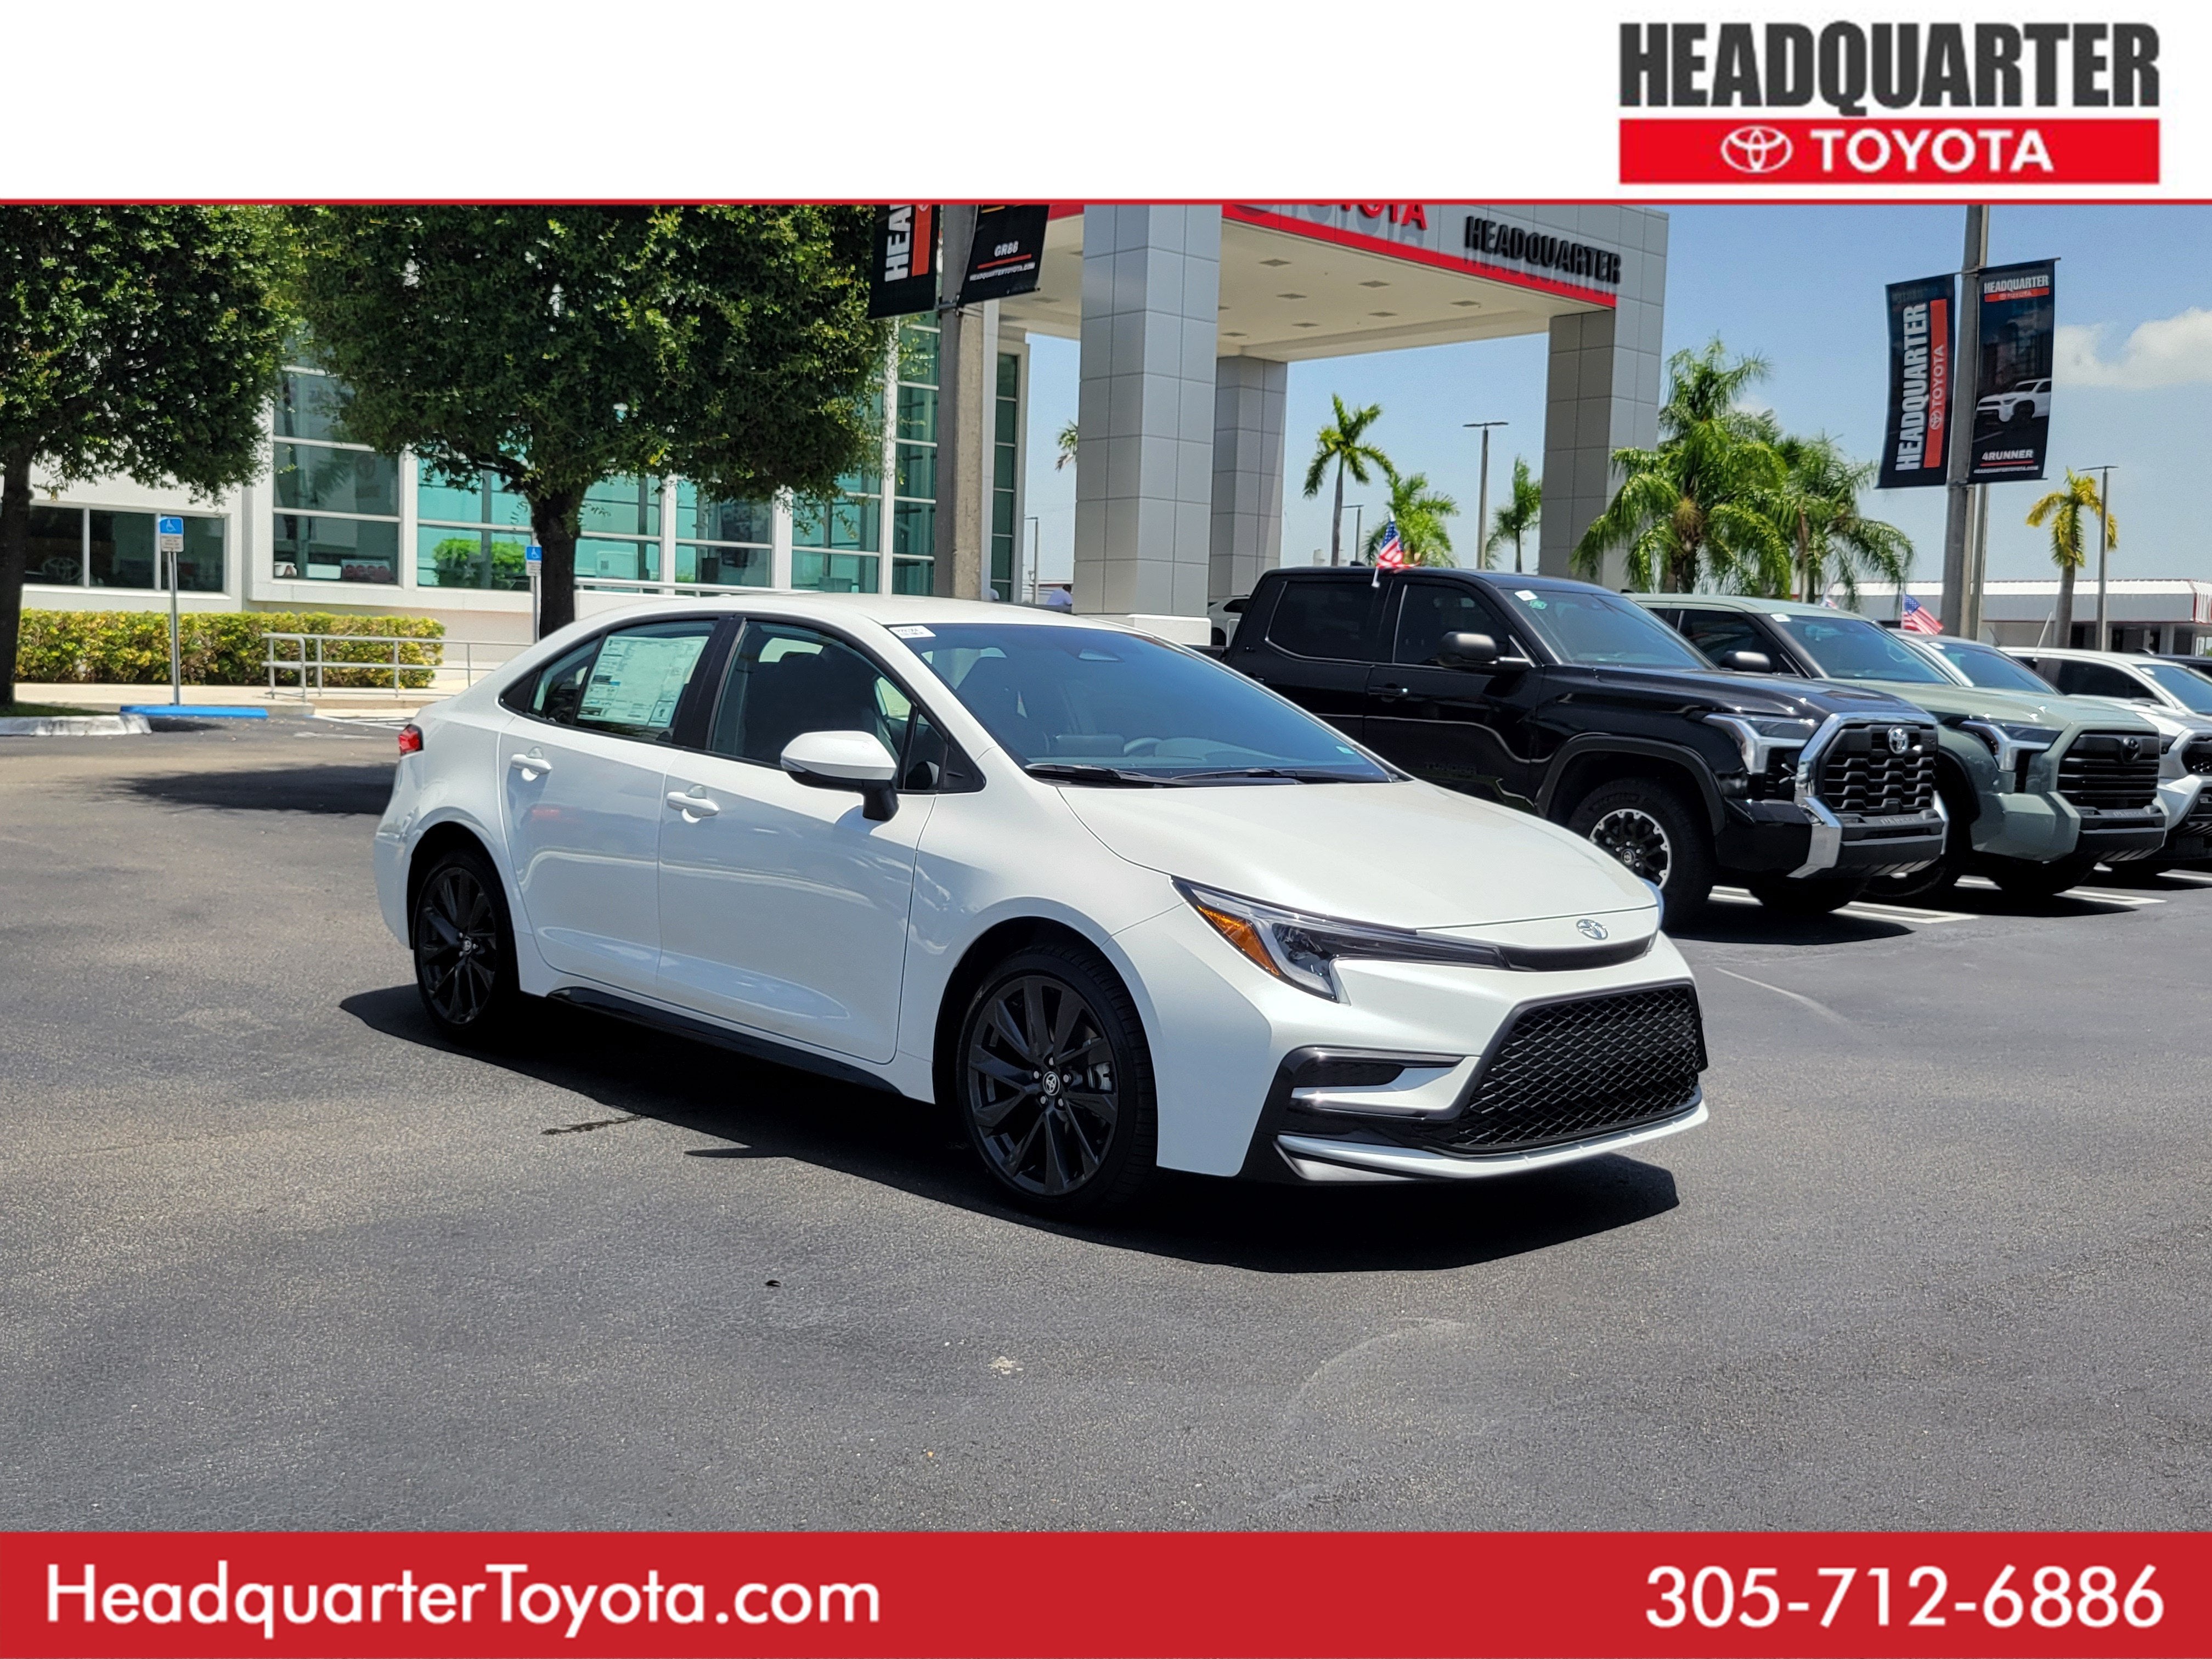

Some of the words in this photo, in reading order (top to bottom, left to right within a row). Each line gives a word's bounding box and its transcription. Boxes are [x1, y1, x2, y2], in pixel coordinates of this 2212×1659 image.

[884, 204, 911, 282] HEA
[1464, 216, 1621, 284] HEADQUARTER
[1984, 275, 2049, 294] HEADQUARTER
[1895, 302, 1928, 471] HEADQUARTER
[1931, 344, 1945, 409] TOYOTA
[1982, 449, 2034, 461] 4RUNNER
